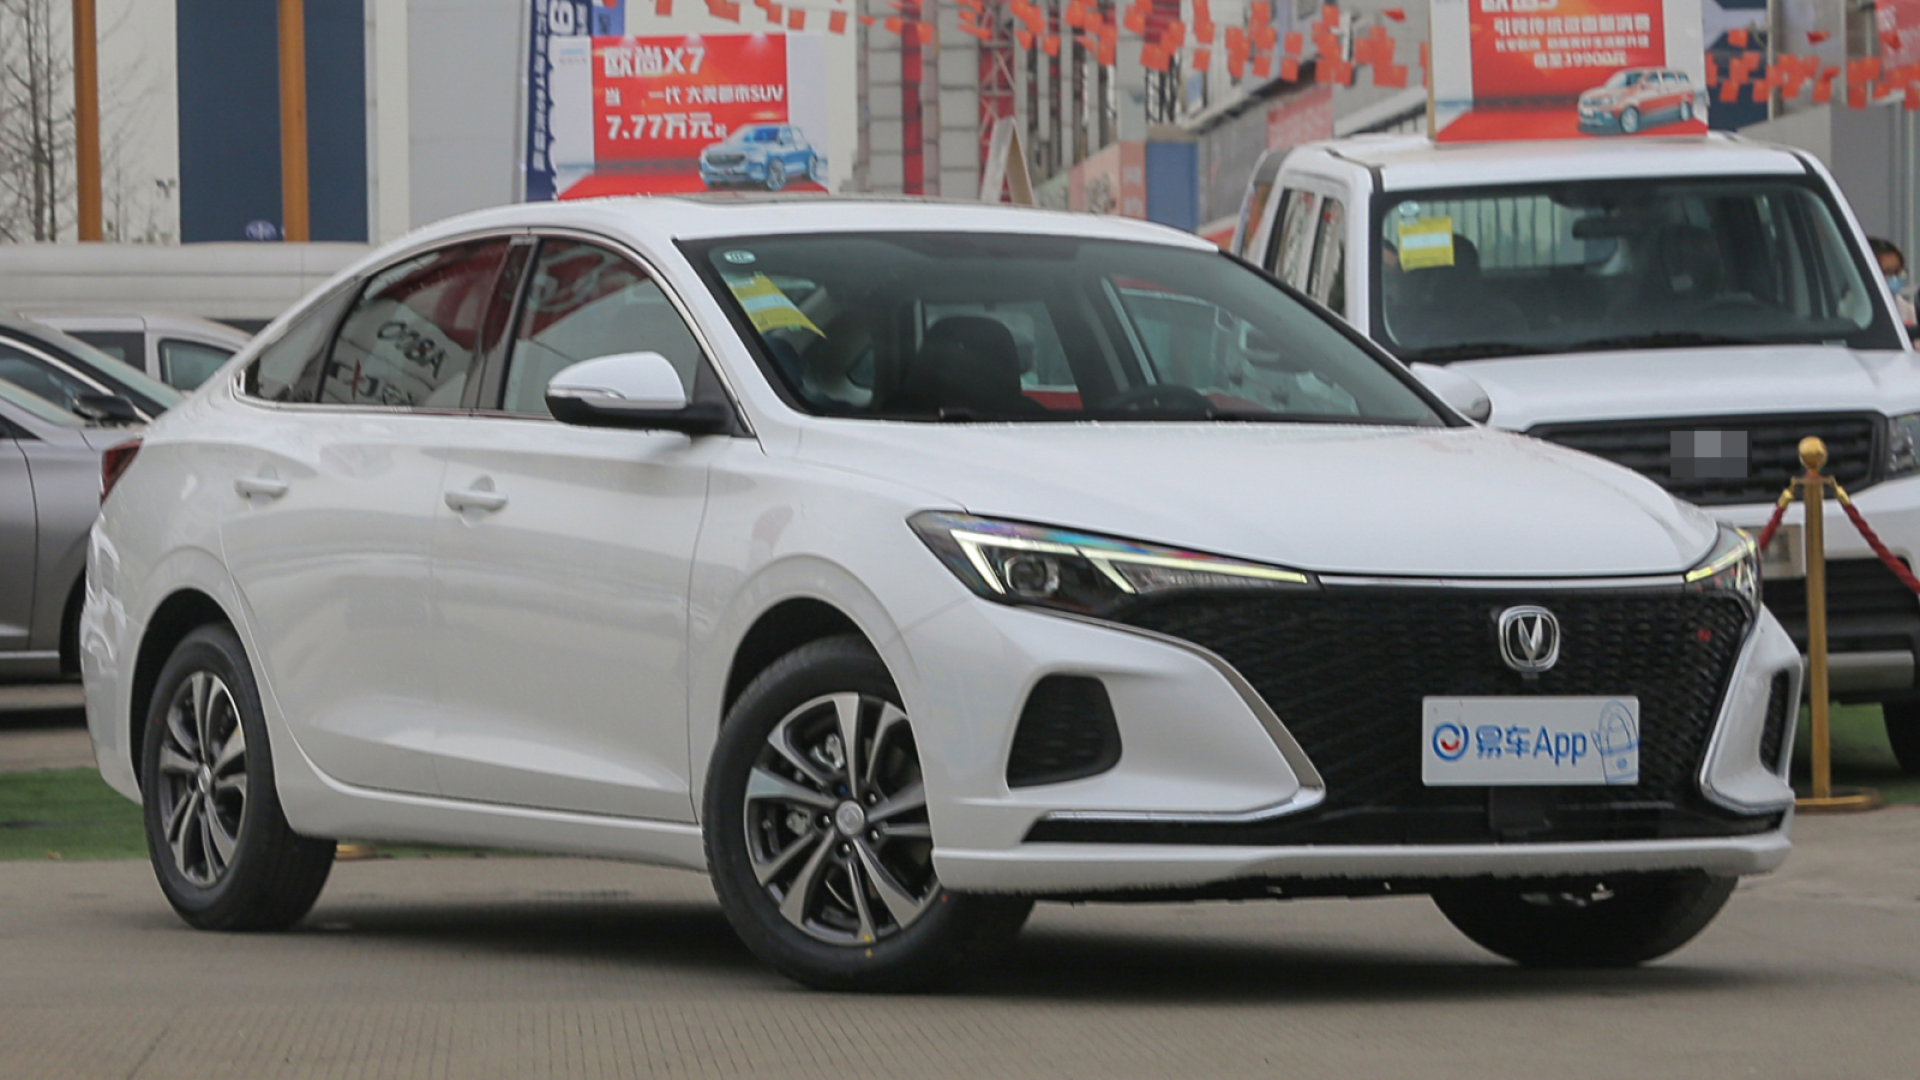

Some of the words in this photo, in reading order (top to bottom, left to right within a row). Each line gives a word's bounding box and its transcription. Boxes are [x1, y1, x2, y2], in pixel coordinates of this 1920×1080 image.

[604, 46, 706, 78] 欧尚X7
[605, 87, 621, 106] 当
[648, 85, 682, 105] 一代
[1476, 725, 1587, 767] 易车App
